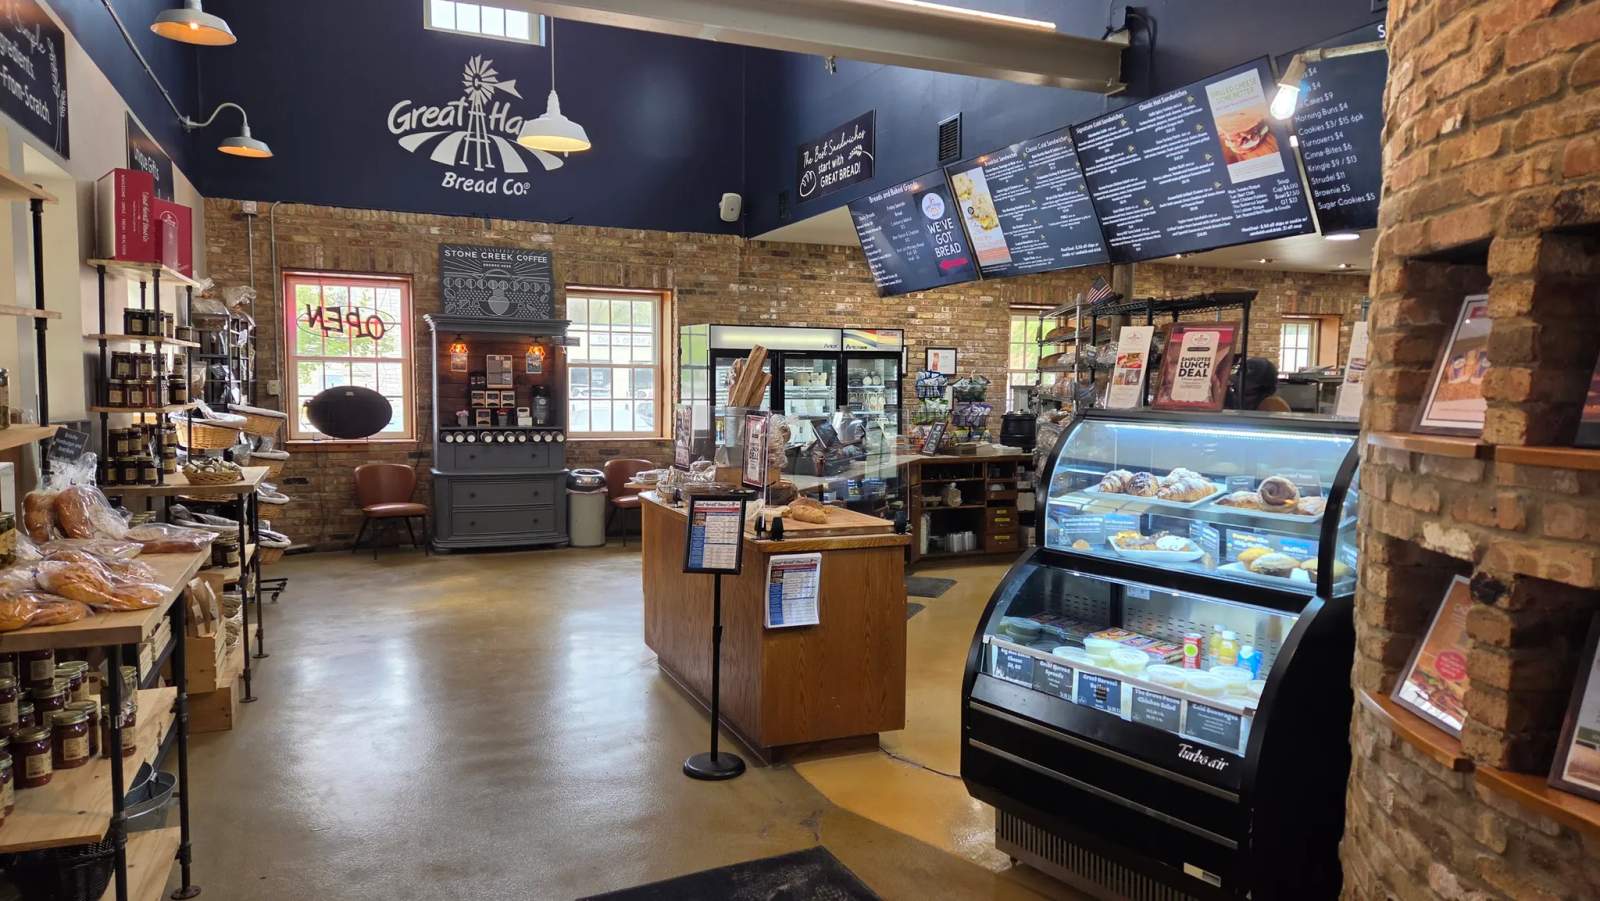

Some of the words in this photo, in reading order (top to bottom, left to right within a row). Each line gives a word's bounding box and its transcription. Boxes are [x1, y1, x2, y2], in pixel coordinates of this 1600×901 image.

[387, 96, 469, 134] Great
[1322, 107, 1339, 117] Buns
[1339, 102, 1349, 112] $4
[1298, 124, 1325, 136] Cookies
[803, 150, 812, 168] The
[814, 145, 827, 162] Best
[828, 124, 866, 156] Sandwiches
[1302, 134, 1335, 148] Turnovers
[1334, 131, 1345, 141] $4
[818, 159, 831, 174] start
[832, 155, 844, 168] with
[1307, 162, 1331, 173] Kringle
[820, 170, 840, 188] GREAT
[839, 162, 861, 182] BREAD!
[1311, 174, 1336, 186] Strudel
[441, 172, 497, 194] Bread
[1314, 187, 1341, 199] Brownie
[1341, 184, 1352, 193] $5
[1318, 201, 1337, 211] Sugar
[1337, 194, 1366, 207] Cookies
[1366, 192, 1377, 202] $5
[927, 218, 954, 234] WE'VE
[935, 231, 953, 245] GOT
[444, 249, 478, 259] STONE
[481, 251, 513, 261] CREEK
[516, 254, 548, 264] COFFEE
[935, 243, 961, 258] BREAD
[1179, 369, 1208, 378] DEAL
[1178, 744, 1209, 765] Turbo
[1208, 758, 1229, 771] air
